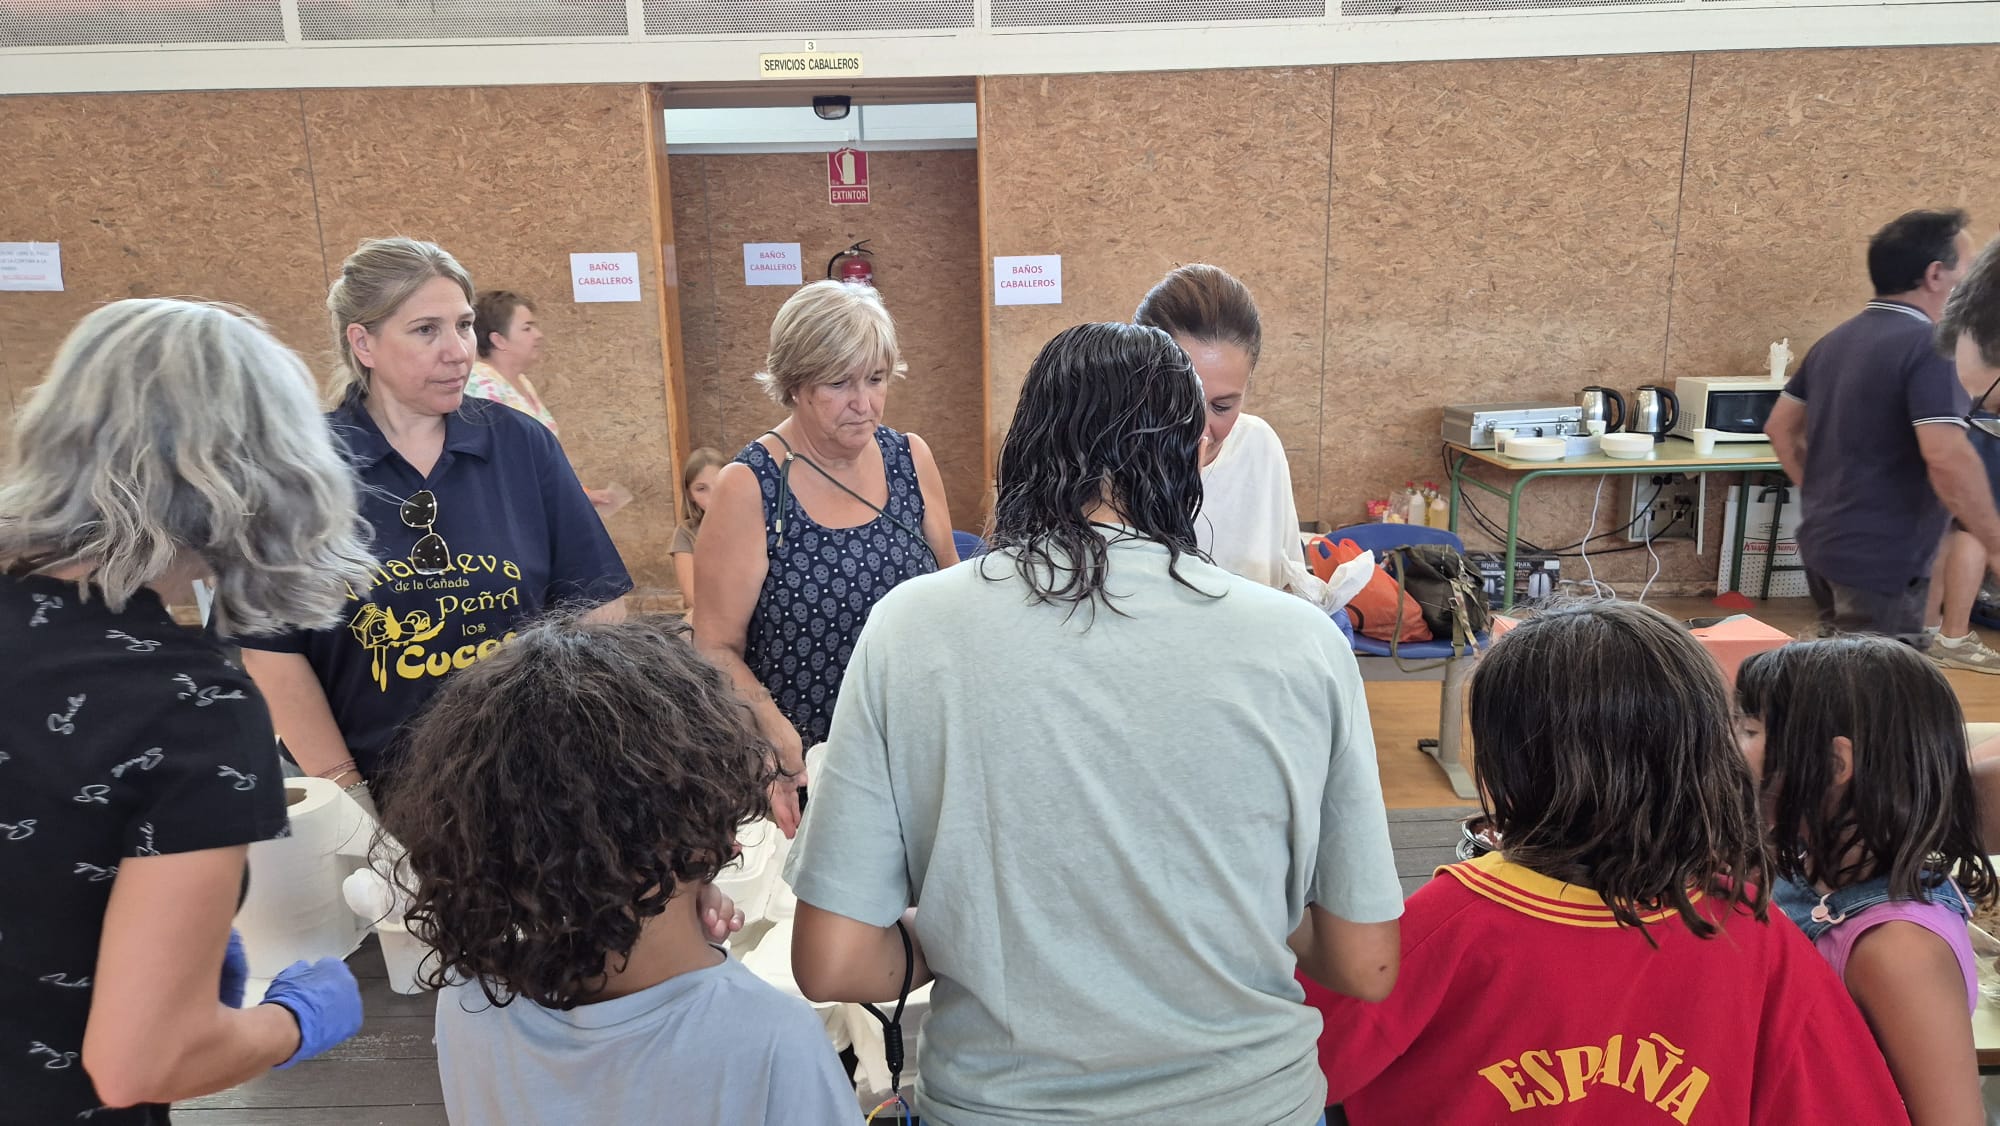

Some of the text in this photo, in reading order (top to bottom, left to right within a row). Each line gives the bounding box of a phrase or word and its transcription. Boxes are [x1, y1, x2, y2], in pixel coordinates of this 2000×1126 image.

[807, 41, 814, 50] 3
[764, 58, 859, 71] SERVICIOS CABALLEROS
[831, 190, 867, 201] EXTINTOR
[759, 250, 786, 259] BAÑOS
[589, 261, 620, 271] BAÑOS
[750, 263, 797, 271] CABALLEROS
[1012, 264, 1043, 275] BAÑOS
[578, 276, 633, 285] CABALLEROS
[1000, 279, 1055, 288] CABALLEROS
[395, 576, 470, 592] de la Cañada
[462, 622, 487, 637] los
[1477, 1032, 1711, 1126] ESPAÑA
